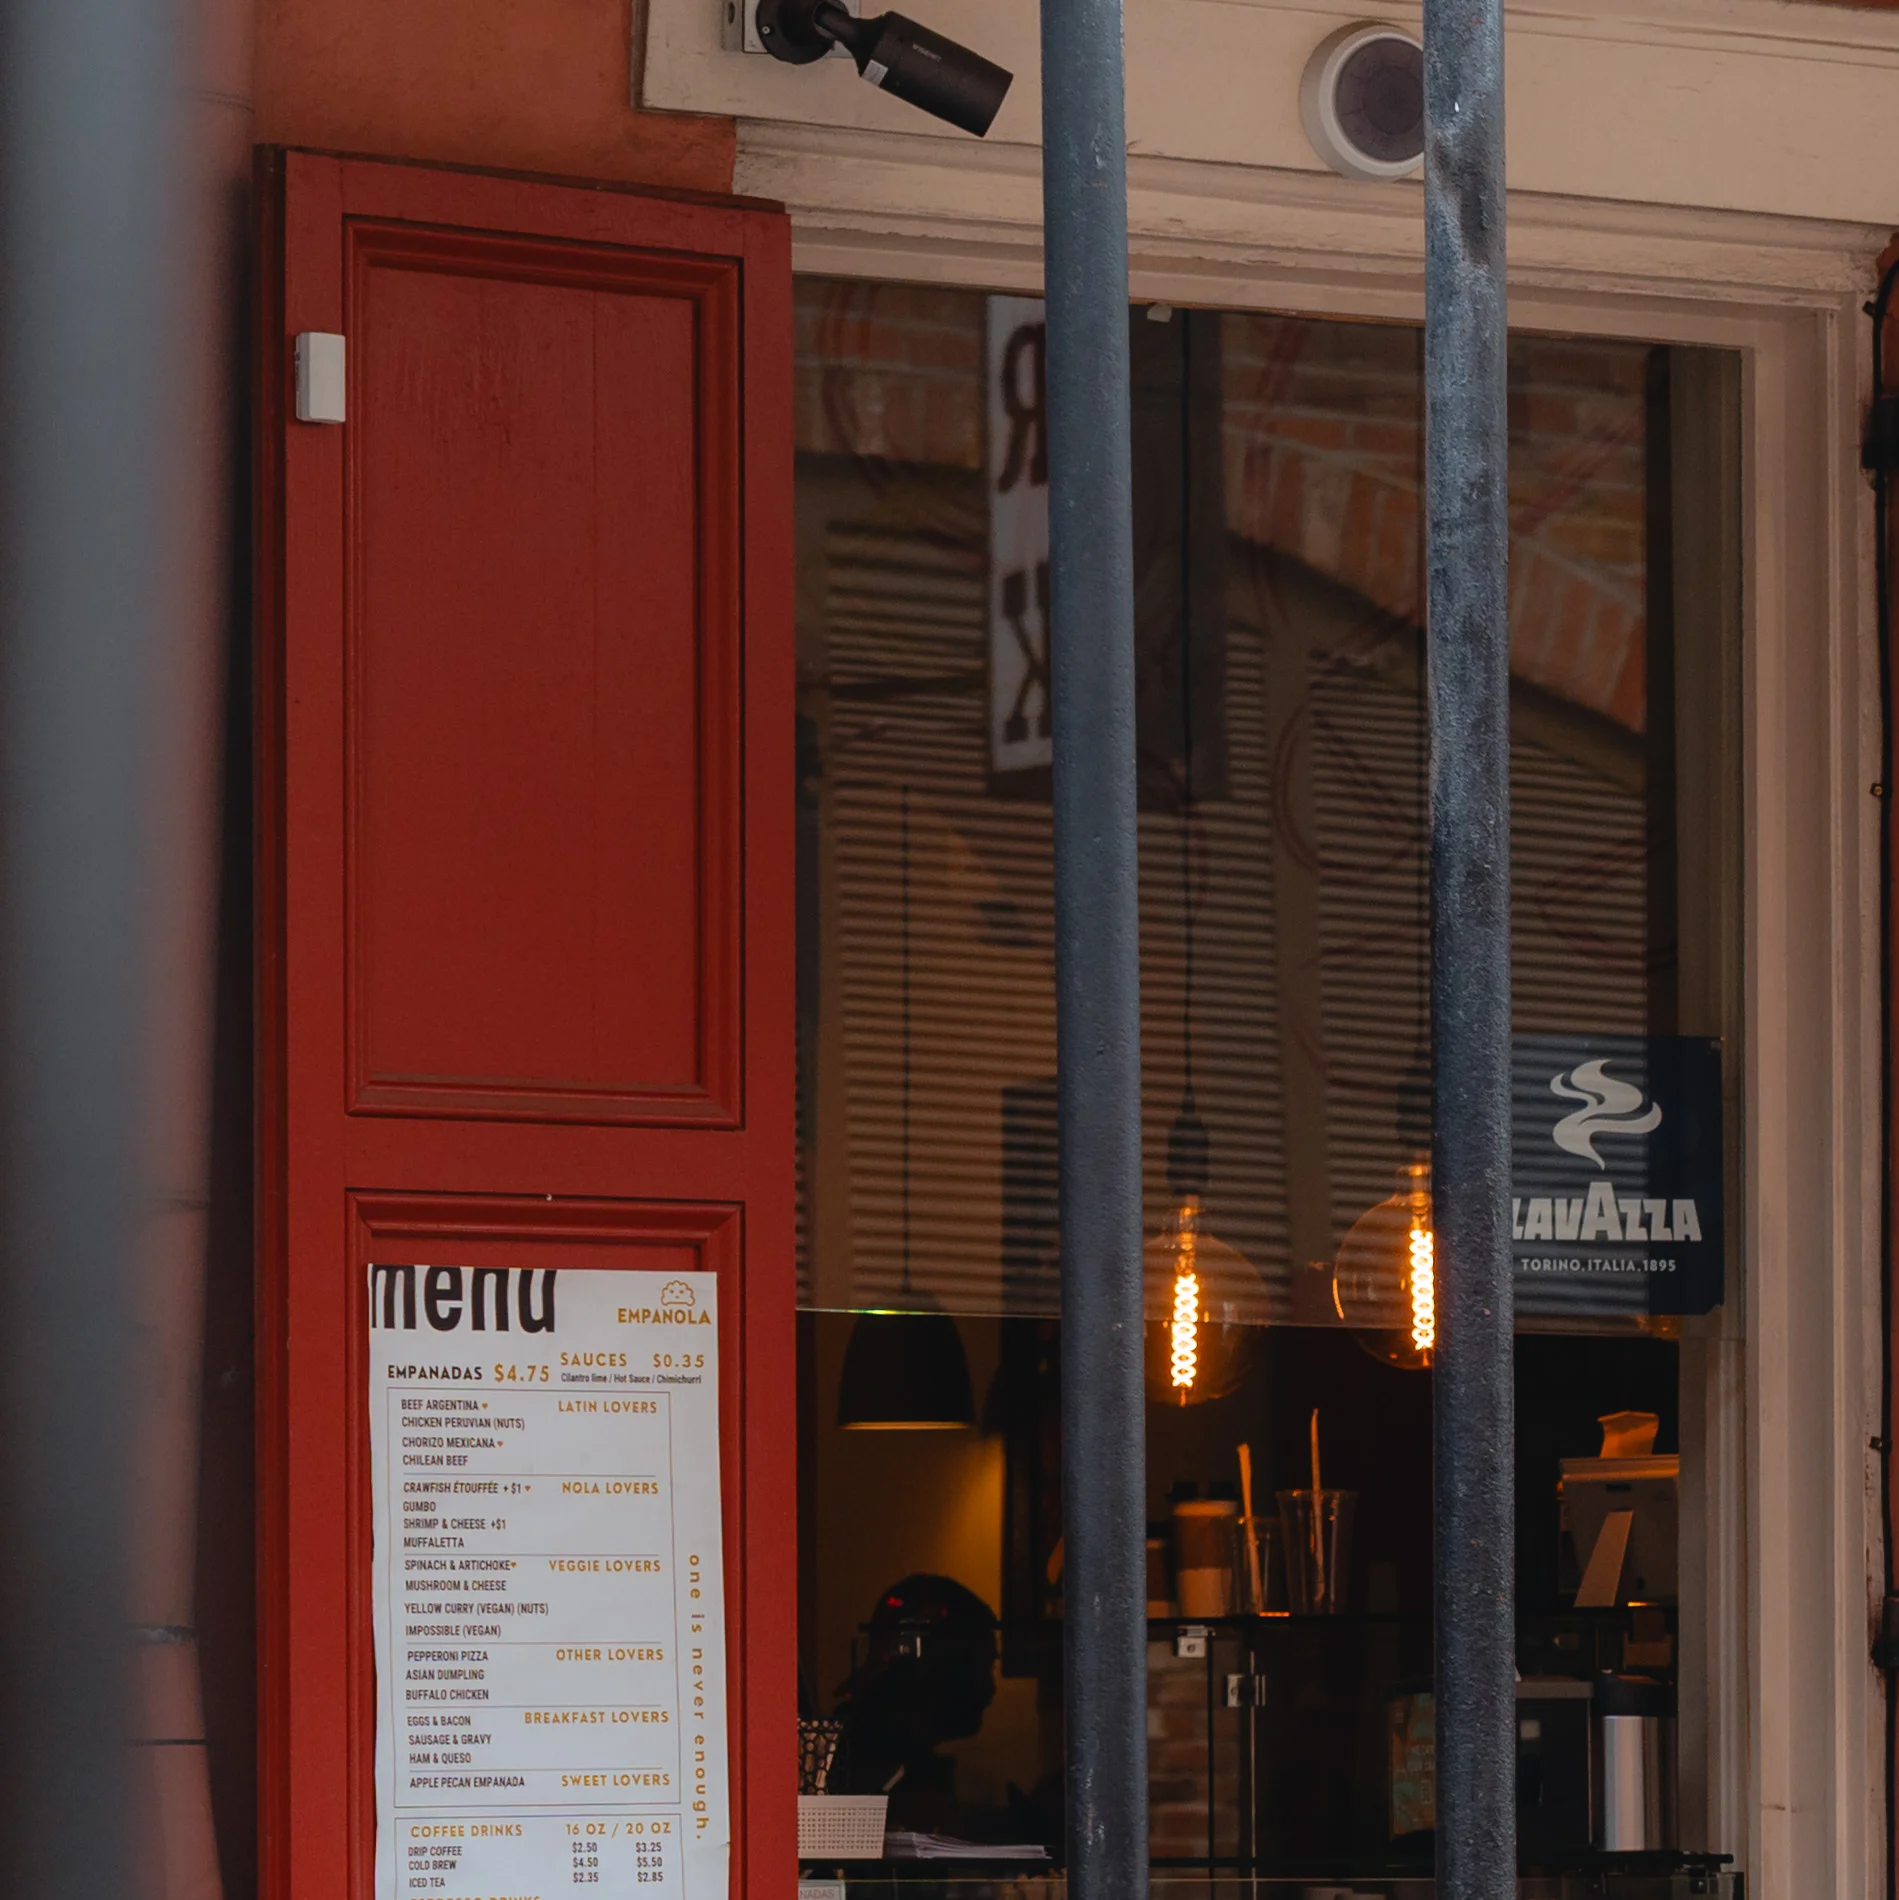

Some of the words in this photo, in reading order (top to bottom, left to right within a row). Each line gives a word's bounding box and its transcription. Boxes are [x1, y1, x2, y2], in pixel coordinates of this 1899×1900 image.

[1512, 1182, 1702, 1241] LAVAZZA
[372, 1264, 557, 1333] menu
[618, 1308, 711, 1324] EMPANOLA
[561, 1353, 626, 1367] SAUCES
[654, 1354, 704, 1368] $0.35
[388, 1365, 482, 1380] EMPANADAS
[494, 1364, 549, 1382] $4.75
[614, 1374, 627, 1383] Hot
[402, 1399, 422, 1410] BEEF
[426, 1400, 478, 1410] ARGENTINA
[559, 1401, 597, 1412] LATIN
[603, 1401, 656, 1413] LOVERS
[402, 1417, 442, 1427] CHICKEN
[445, 1417, 491, 1427] PERUVIAN
[494, 1418, 525, 1430] (NUTS)
[402, 1437, 444, 1447] CHORIZO
[447, 1437, 495, 1448] MEXICANA
[403, 1455, 443, 1465] CHILEAN
[446, 1455, 468, 1466] BEEF
[404, 1482, 451, 1493] CRAWFISH
[453, 1482, 498, 1493] ÉTOUFFÉE
[562, 1482, 599, 1494] NOLA
[606, 1482, 658, 1494] LOVERS
[403, 1501, 436, 1512] GUMBO
[404, 1518, 438, 1529] SHRIMP
[451, 1519, 485, 1529] CHEESE
[404, 1537, 464, 1547] MUFFALETTA
[405, 1560, 446, 1570] SPINACH
[459, 1560, 511, 1570] ARTICHOKE
[549, 1560, 599, 1571] VEGGIE
[606, 1560, 660, 1572] LOVERS
[406, 1580, 460, 1591] MUSHROOM
[472, 1580, 506, 1591] CHEESE
[405, 1603, 442, 1614] YELLOW
[445, 1603, 474, 1614] CURRY
[477, 1603, 514, 1615] (VEGAN)
[517, 1603, 548, 1615] (NUTS)
[406, 1625, 460, 1636] IMPOSSIBLE
[463, 1625, 501, 1637] (VEGAN)
[408, 1651, 458, 1661] PEPPERONI
[461, 1651, 488, 1661] PIZZA
[556, 1649, 601, 1661] OTHER
[608, 1649, 663, 1660] LOVERS
[406, 1670, 434, 1680] ASIAN
[438, 1669, 484, 1680] DUMPLING
[406, 1690, 447, 1700] BUFFALO
[450, 1689, 488, 1700] CHICKEN
[407, 1716, 430, 1726] EGGS
[441, 1716, 471, 1726] BACON
[525, 1712, 604, 1723] BREAKFAST
[612, 1711, 669, 1723] LOVERS
[409, 1735, 450, 1745] SAUSAGE
[461, 1734, 491, 1744] GRAVY
[410, 1753, 430, 1763] HAM
[442, 1753, 471, 1764] QUESO
[410, 1777, 438, 1788] APPLE
[441, 1777, 471, 1788] PECAN
[474, 1777, 524, 1787] EMPANADA
[562, 1775, 606, 1786] SWEET
[614, 1774, 670, 1786] LOVERS
[411, 1826, 464, 1837] COFFEE
[471, 1824, 522, 1836] DRINKS
[567, 1824, 579, 1835] 16
[586, 1823, 605, 1835] OZ
[626, 1823, 644, 1834] 20
[651, 1822, 671, 1834] OZ
[408, 1847, 428, 1856] DRIP
[430, 1846, 462, 1856] COFFEE
[572, 1842, 597, 1853] $2.50
[636, 1842, 661, 1853] $3.25
[409, 1860, 430, 1870] COLD
[432, 1860, 456, 1870] BREW
[573, 1857, 598, 1868] $4.50
[637, 1857, 662, 1867] $5.50
[409, 1878, 427, 1888] ICED
[430, 1877, 445, 1887] TEA
[573, 1872, 598, 1883] $2.35
[638, 1871, 663, 1882] $2.85
[798, 1889, 834, 1900] NADAS
